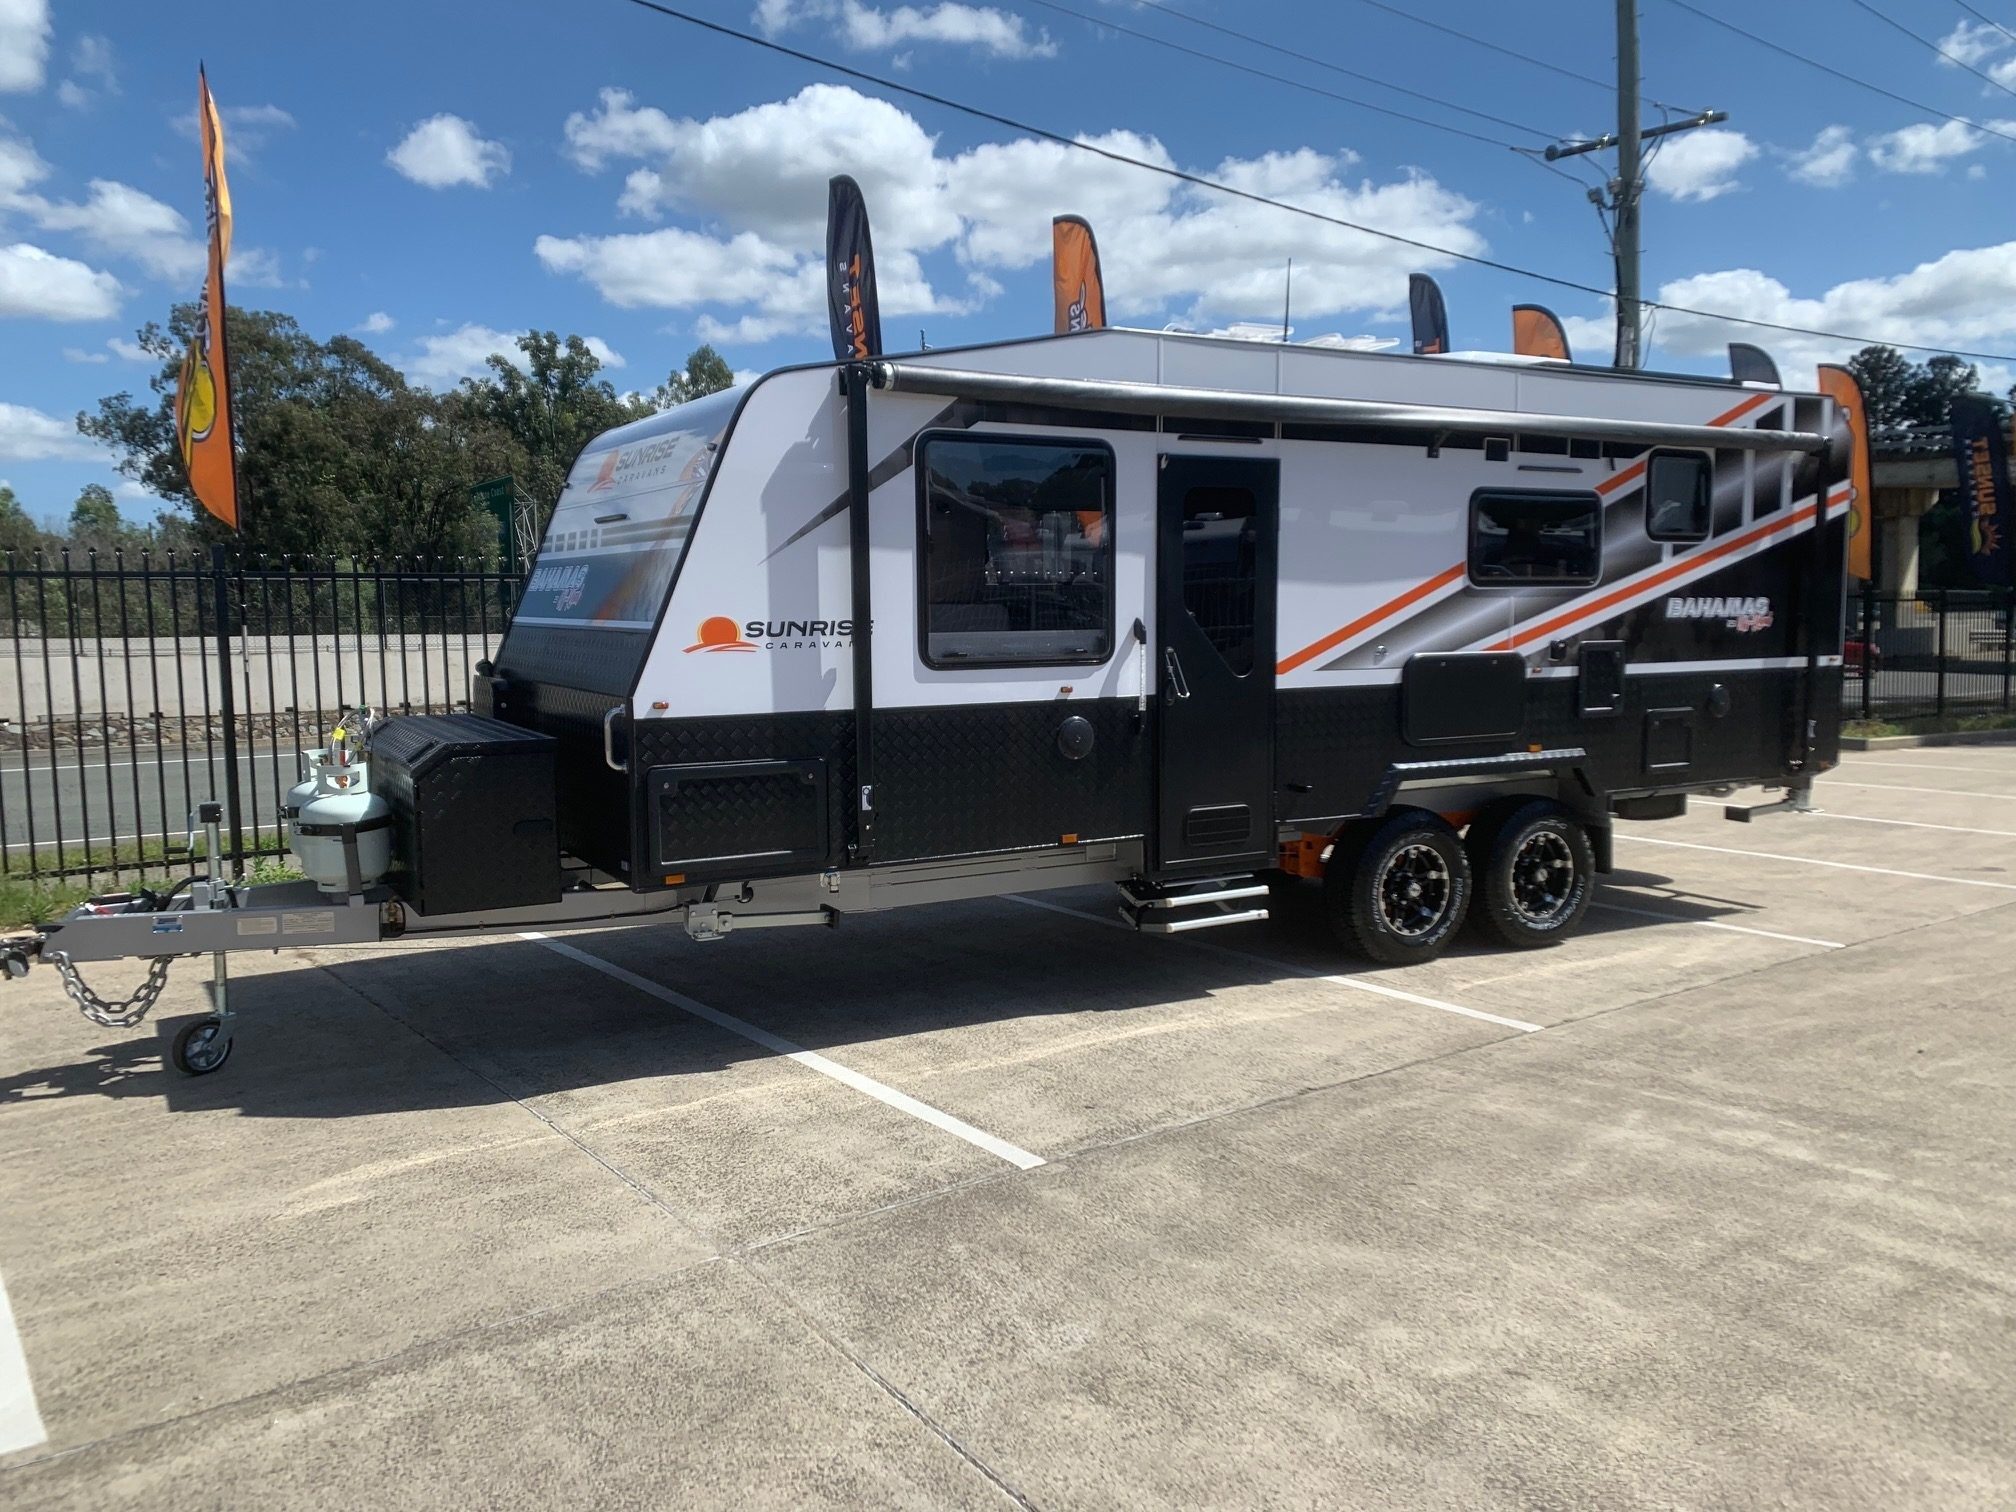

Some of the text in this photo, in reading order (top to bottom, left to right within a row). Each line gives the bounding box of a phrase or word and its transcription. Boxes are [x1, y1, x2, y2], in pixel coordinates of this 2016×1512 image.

[616, 436, 681, 472] SUNRISE
[616, 465, 667, 485] CARAVANS
[528, 564, 589, 592] BAHAMAS
[1665, 597, 1771, 618] BAHAMAS
[765, 640, 854, 650] CARAVA
